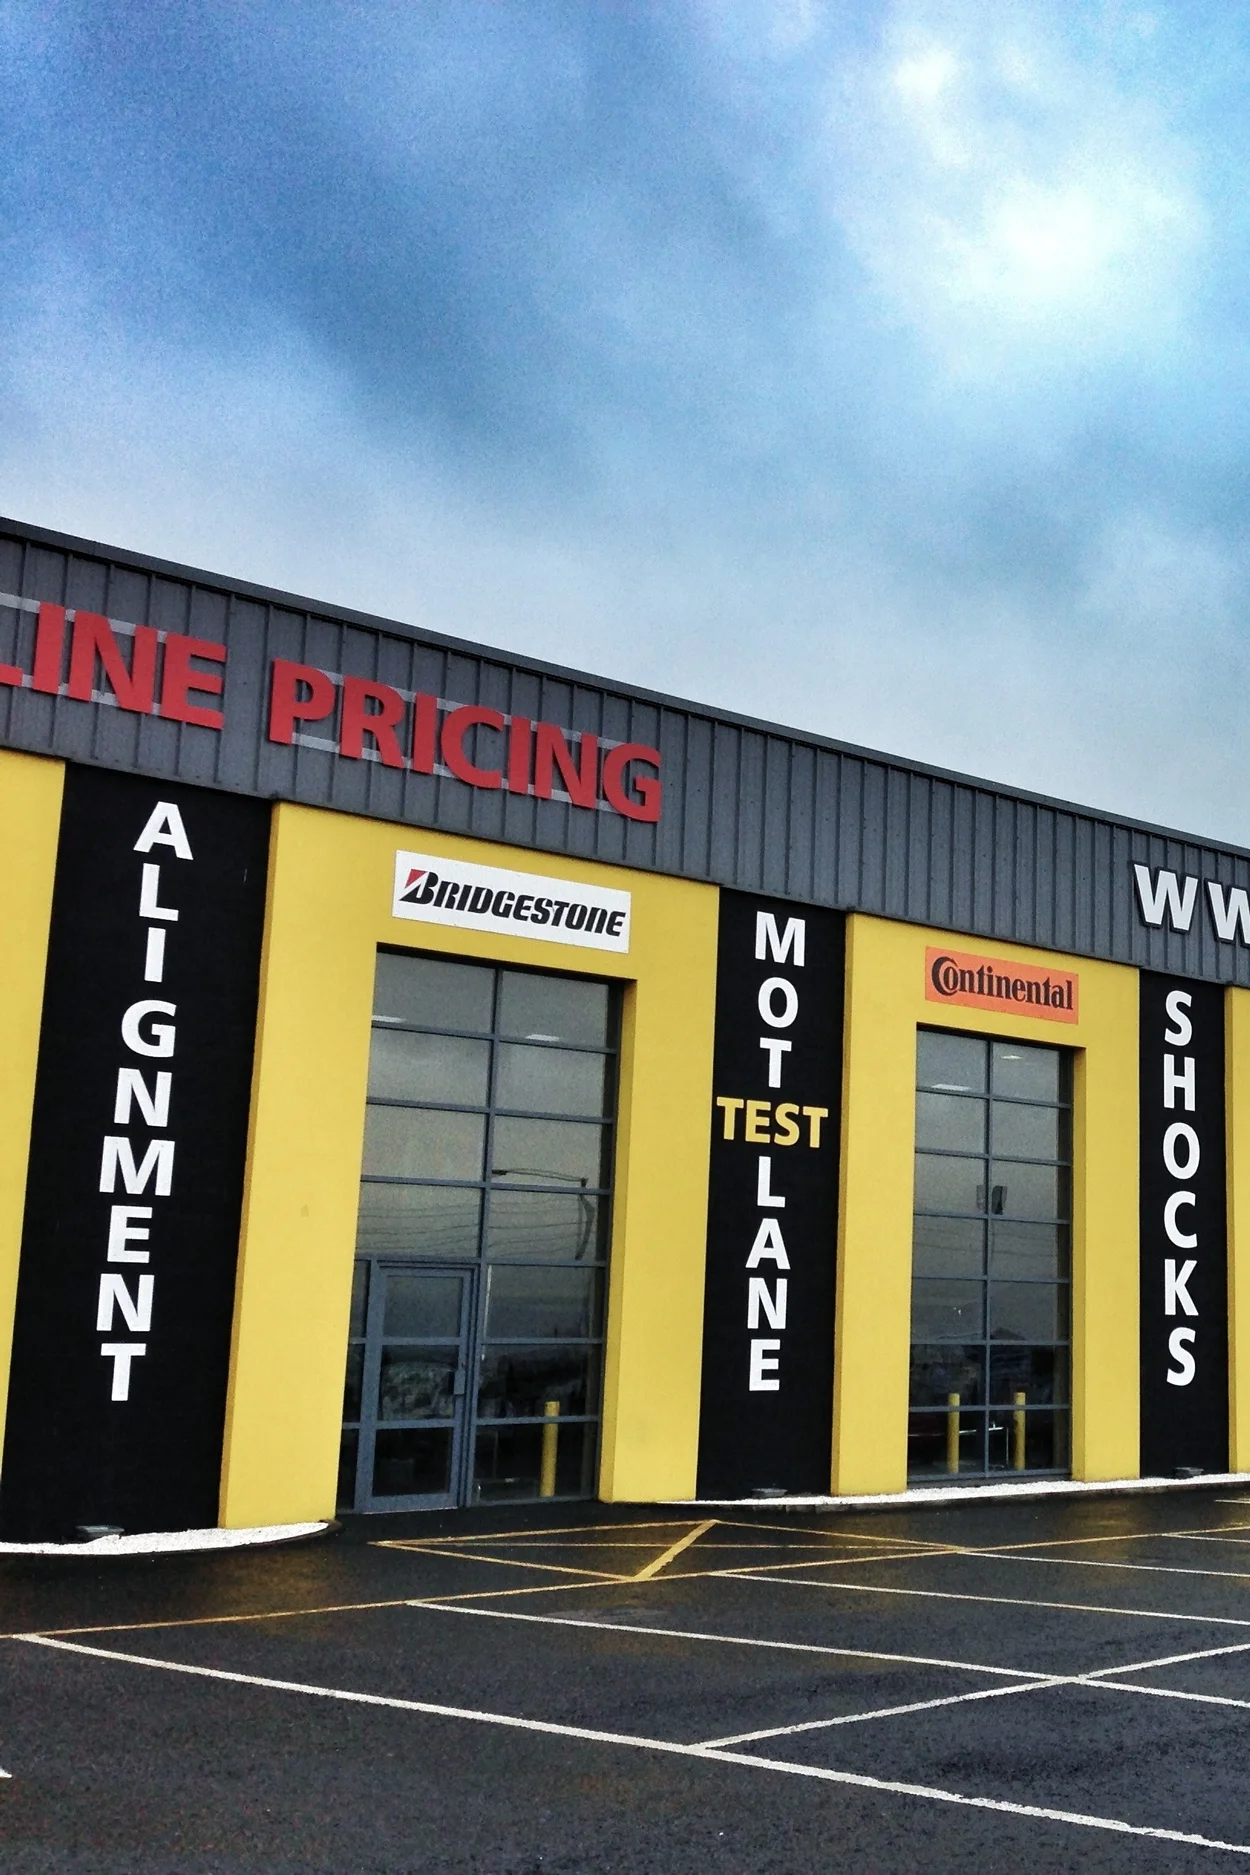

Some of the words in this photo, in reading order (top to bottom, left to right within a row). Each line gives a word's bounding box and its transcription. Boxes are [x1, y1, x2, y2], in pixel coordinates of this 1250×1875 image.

[269, 658, 662, 823] PRICING
[399, 869, 626, 937] BRIDGESTONE
[931, 956, 1074, 1011] Continental
[754, 911, 806, 1089] MOT
[95, 801, 194, 1402] ALIGNMENT
[716, 1096, 828, 1149] TEST
[745, 1156, 791, 1392] LANE
[1162, 990, 1201, 1387] SHOCKS
